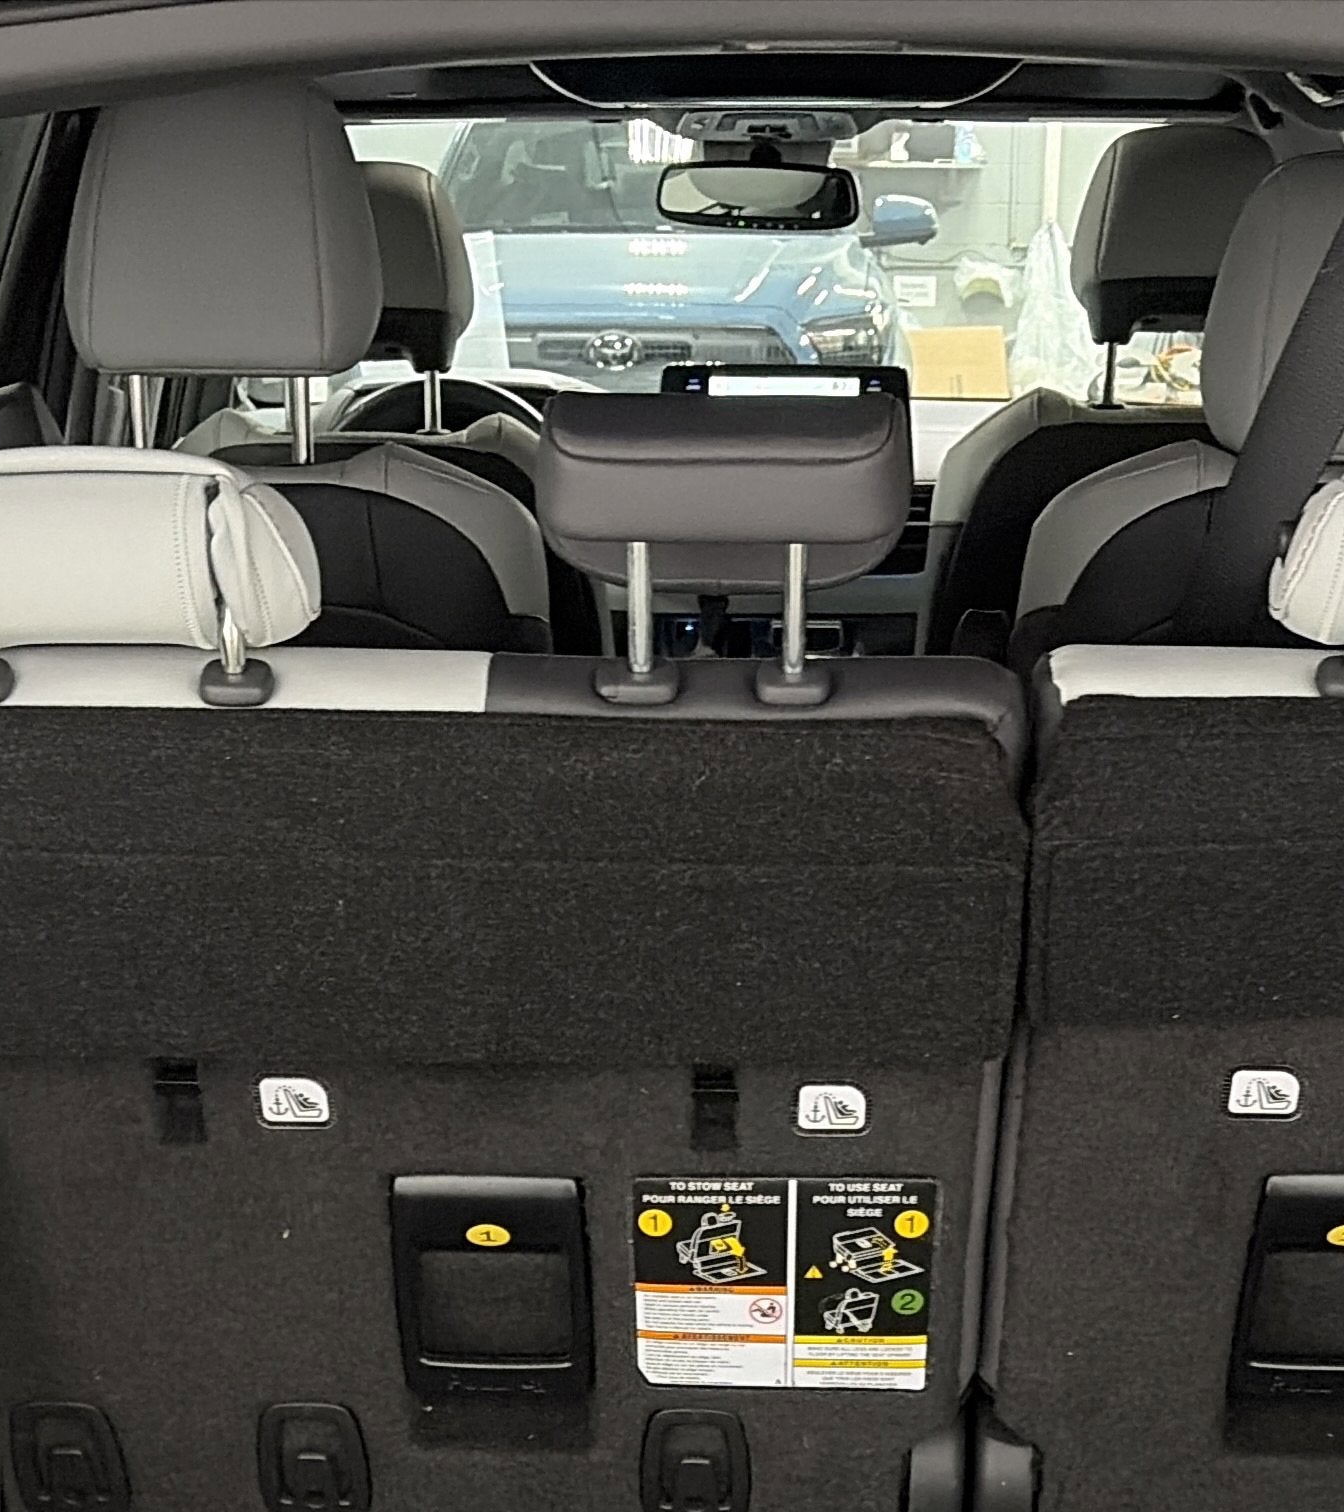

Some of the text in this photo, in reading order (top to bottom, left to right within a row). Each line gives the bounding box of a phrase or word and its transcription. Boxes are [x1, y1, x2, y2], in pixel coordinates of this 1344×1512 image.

[669, 1181, 755, 1191] TO STOW SEAT
[828, 1183, 904, 1192] TO USE SEAT
[642, 1194, 675, 1203] POUR
[676, 1195, 727, 1204] RANGER
[728, 1196, 744, 1204] LE
[812, 1195, 918, 1204] POUR UTILISER LE
